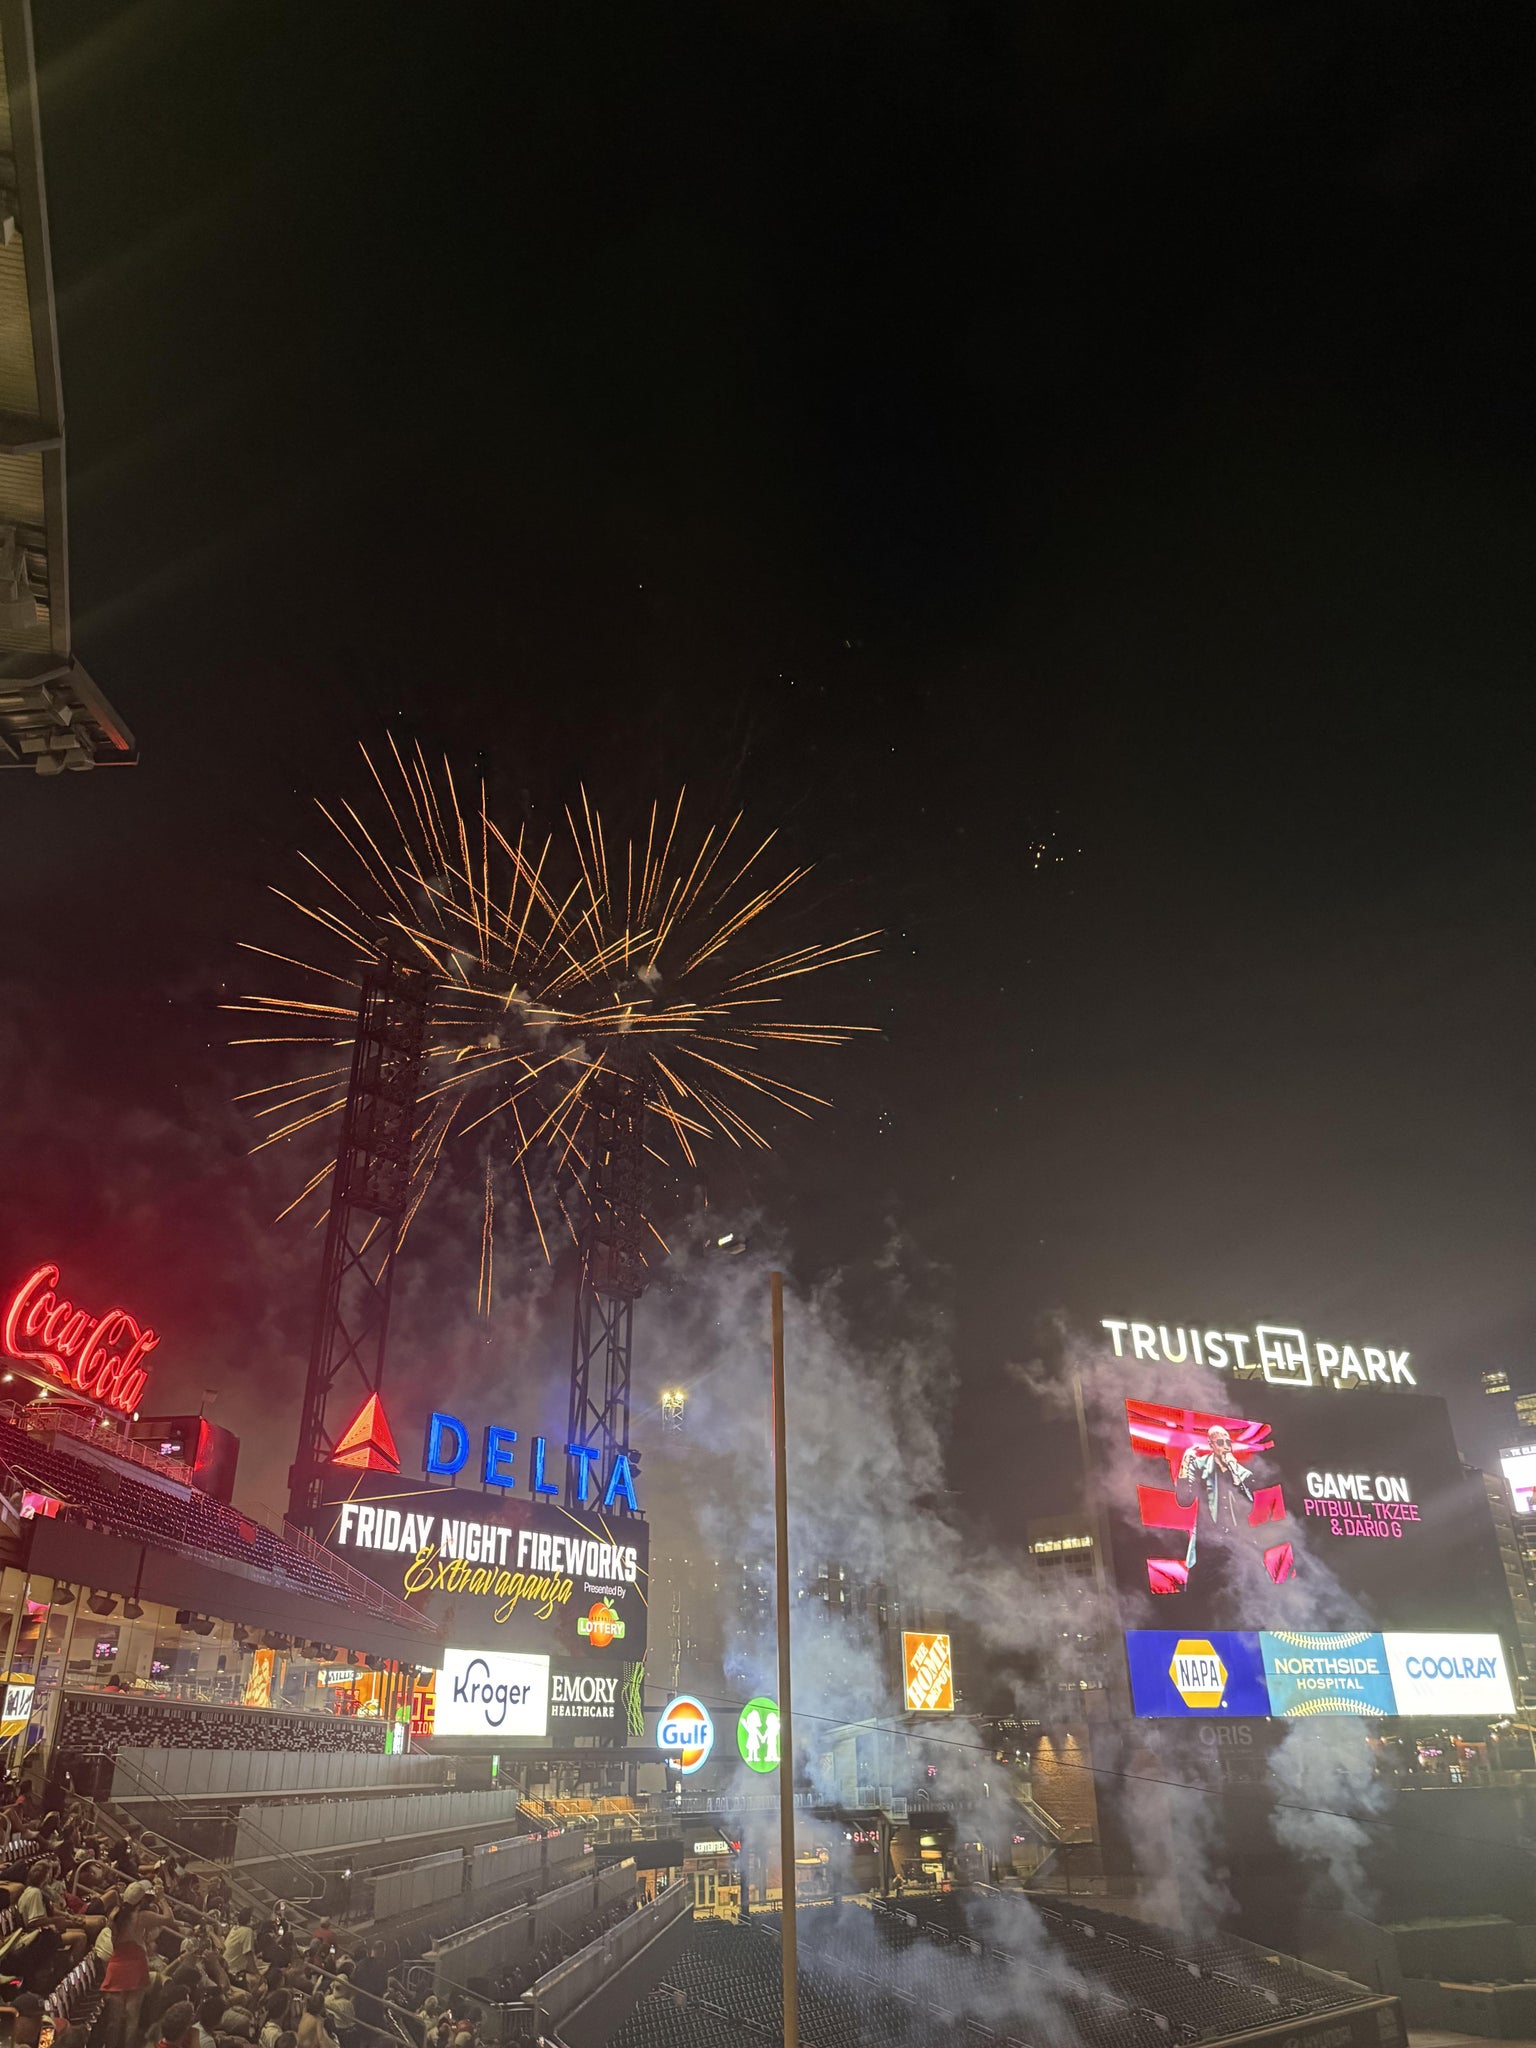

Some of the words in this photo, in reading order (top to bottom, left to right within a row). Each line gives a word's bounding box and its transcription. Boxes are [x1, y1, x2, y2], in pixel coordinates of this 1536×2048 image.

[6, 1264, 161, 1414] Coca-Cola
[1102, 1320, 1250, 1369] TRUIST
[1315, 1342, 1417, 1386] PARK
[426, 1412, 639, 1512] DELTA
[1306, 1472, 1374, 1501] GAME
[1375, 1476, 1410, 1503] ON
[1304, 1499, 1372, 1520] PITBULL,
[1372, 1502, 1421, 1521] TKZEE
[1330, 1519, 1344, 1536] &
[1344, 1519, 1390, 1538] DARIO
[1391, 1521, 1403, 1539] G
[338, 1503, 435, 1554] FRIDAY
[440, 1518, 512, 1567] NIGHT
[517, 1530, 638, 1583] FIREWORKS
[403, 1545, 574, 1624] Extravaganza
[584, 1582, 617, 1596] Presented
[617, 1586, 626, 1599] By
[580, 1621, 623, 1635] LOTTERY
[907, 1635, 949, 1709] HOME
[1180, 1659, 1220, 1687] NAPA
[1274, 1657, 1380, 1675] NORTHSIDE
[1406, 1656, 1497, 1679] COOLRAY
[453, 1658, 531, 1727] Kroger
[551, 1675, 619, 1703] EMORY
[1296, 1678, 1365, 1690] HOSPITAL
[551, 1705, 615, 1718] HEALTHCARE
[662, 1724, 708, 1745] Gulf
[1200, 1724, 1253, 1746] ORIS
